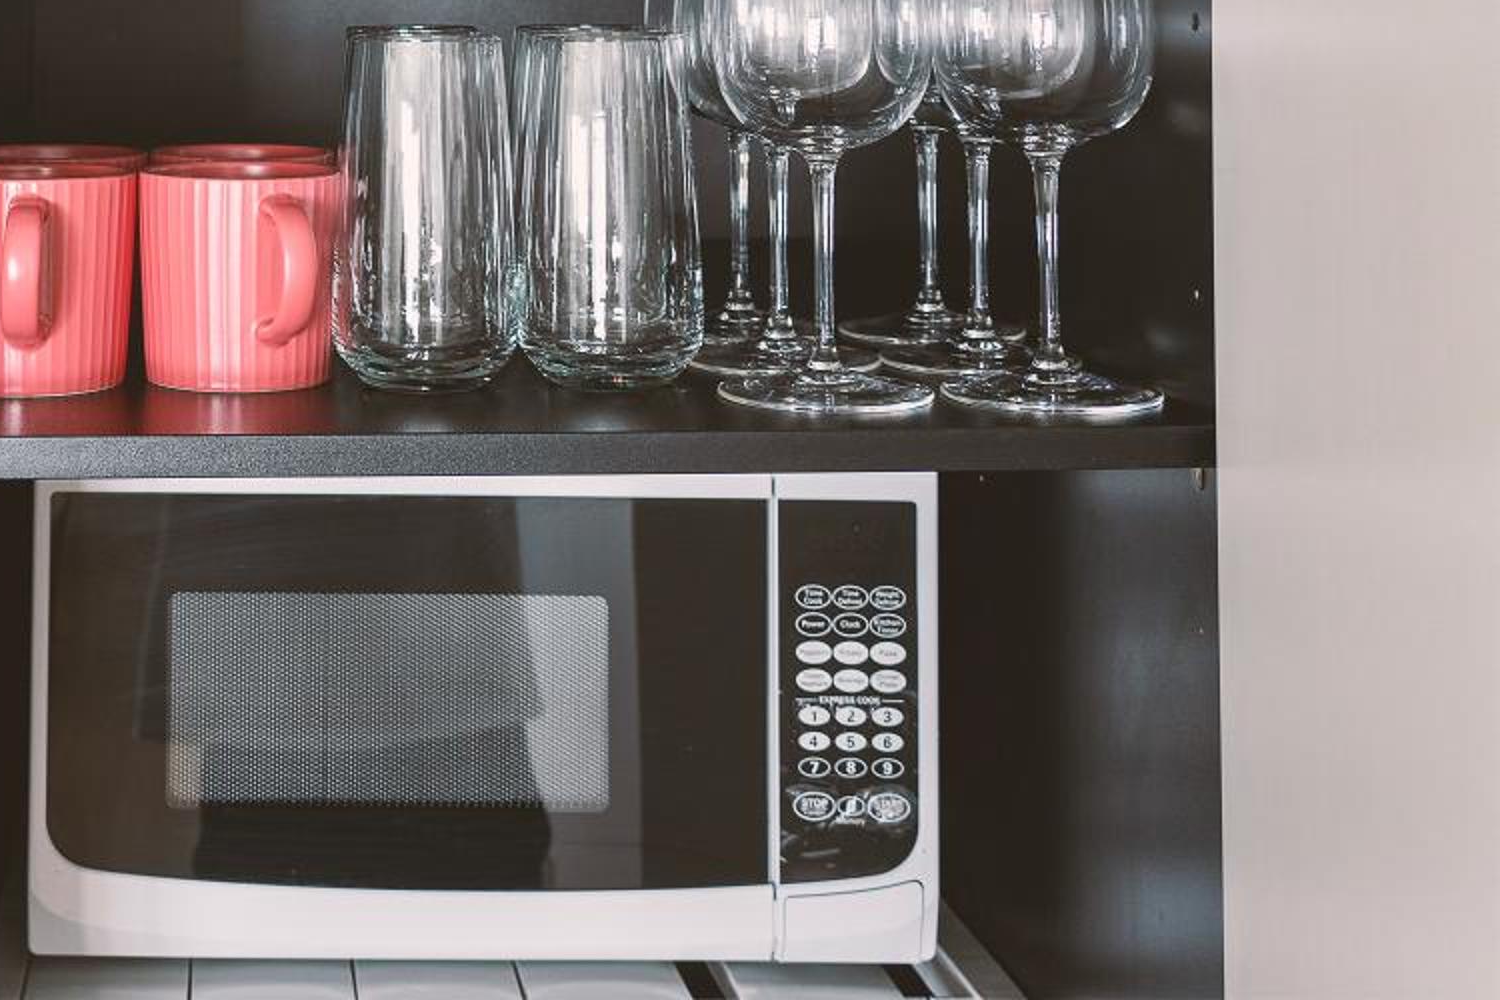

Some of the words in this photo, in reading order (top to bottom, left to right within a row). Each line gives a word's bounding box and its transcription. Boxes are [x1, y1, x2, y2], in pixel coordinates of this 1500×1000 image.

[812, 711, 817, 722] 1
[846, 710, 855, 722] 2
[883, 710, 892, 722] 3
[809, 735, 818, 747] 4
[845, 736, 855, 748] 5
[883, 736, 893, 749] 6
[809, 761, 819, 774] 7
[845, 761, 857, 775] 8
[882, 761, 893, 775] 9
